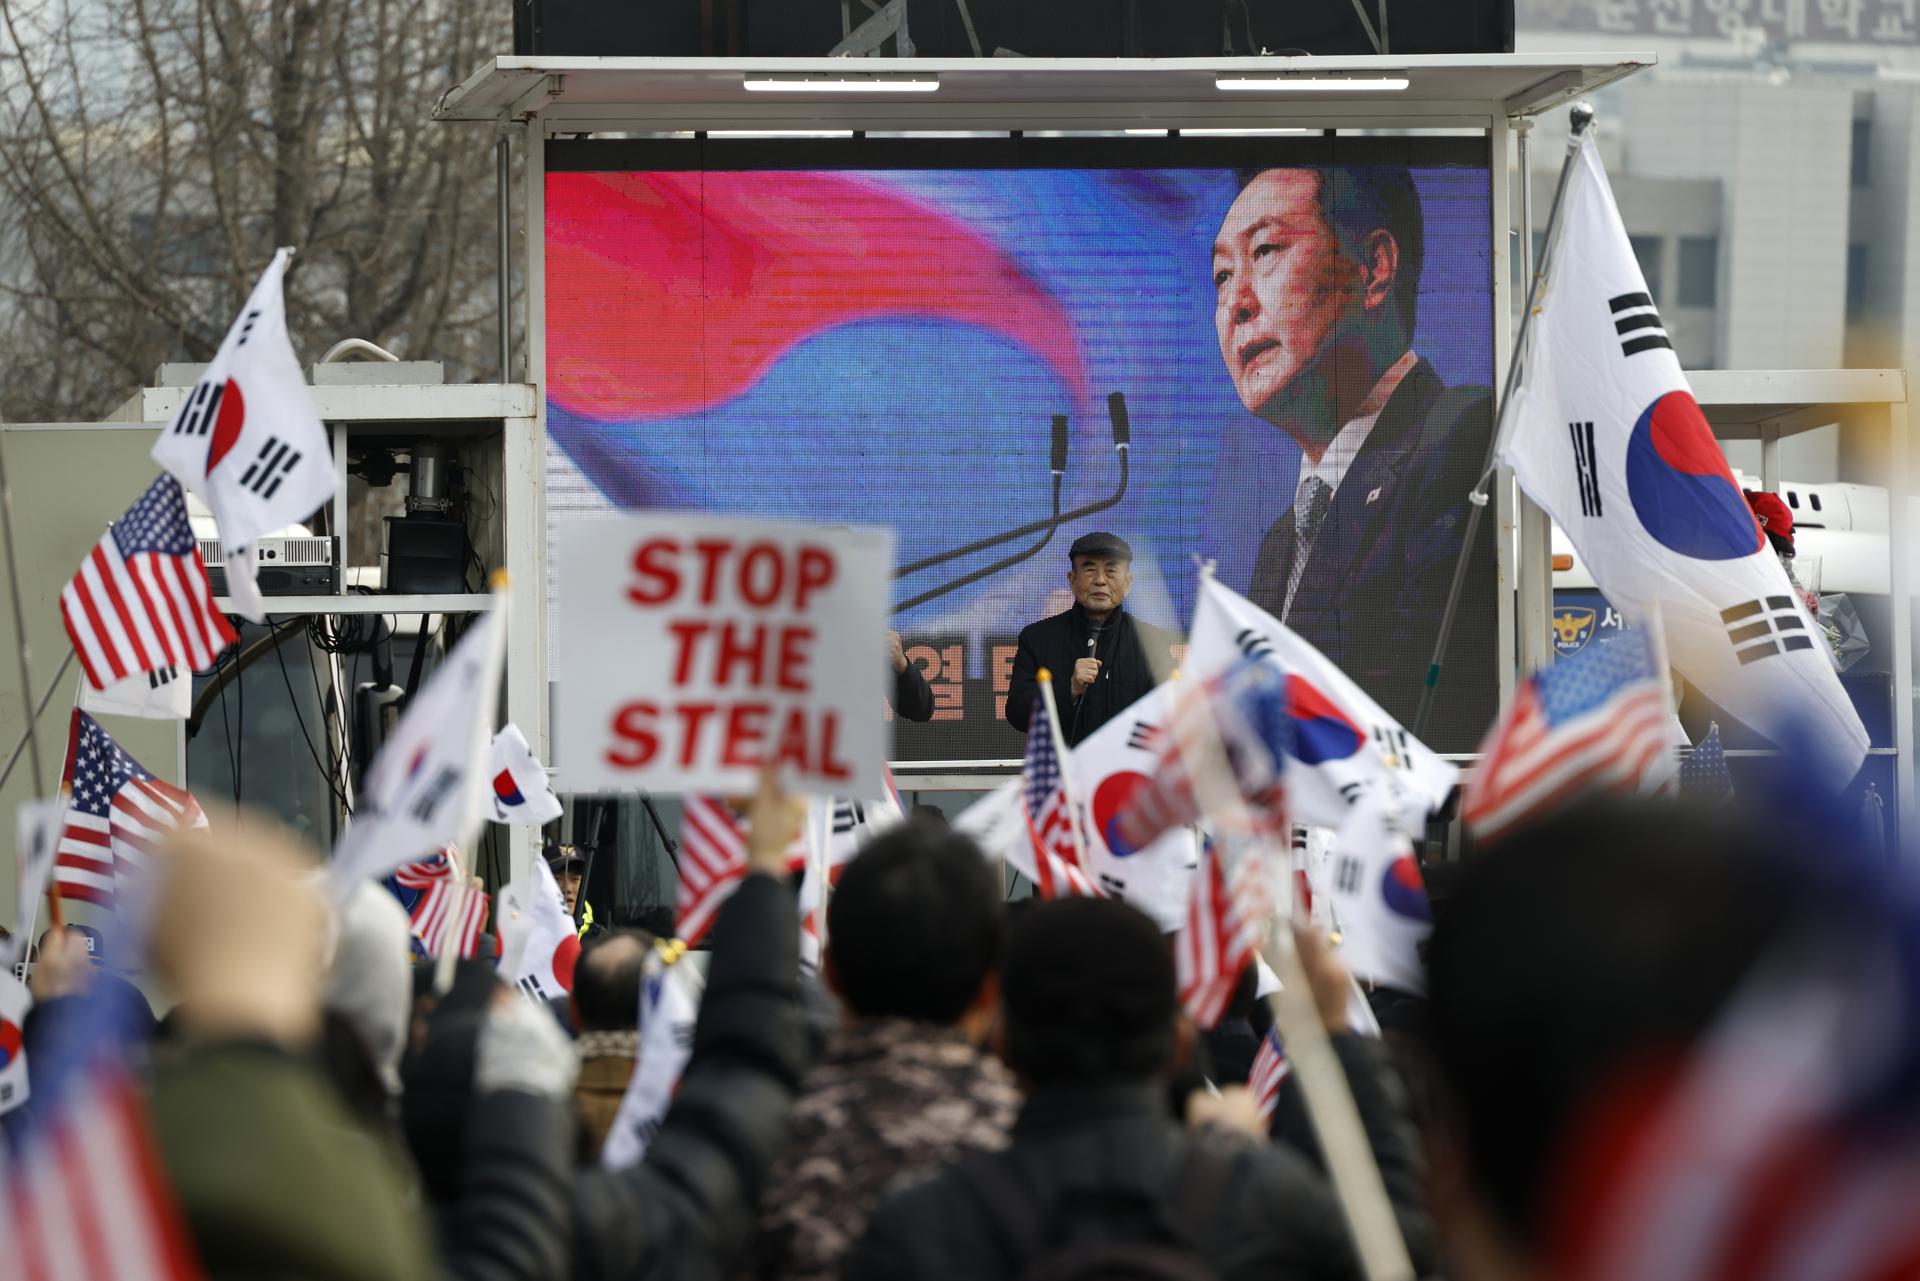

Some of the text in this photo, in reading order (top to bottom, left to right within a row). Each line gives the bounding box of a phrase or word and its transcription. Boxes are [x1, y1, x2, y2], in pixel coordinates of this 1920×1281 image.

[626, 537, 836, 613] STOP
[667, 620, 817, 694] THE
[604, 700, 853, 781] STEAL
